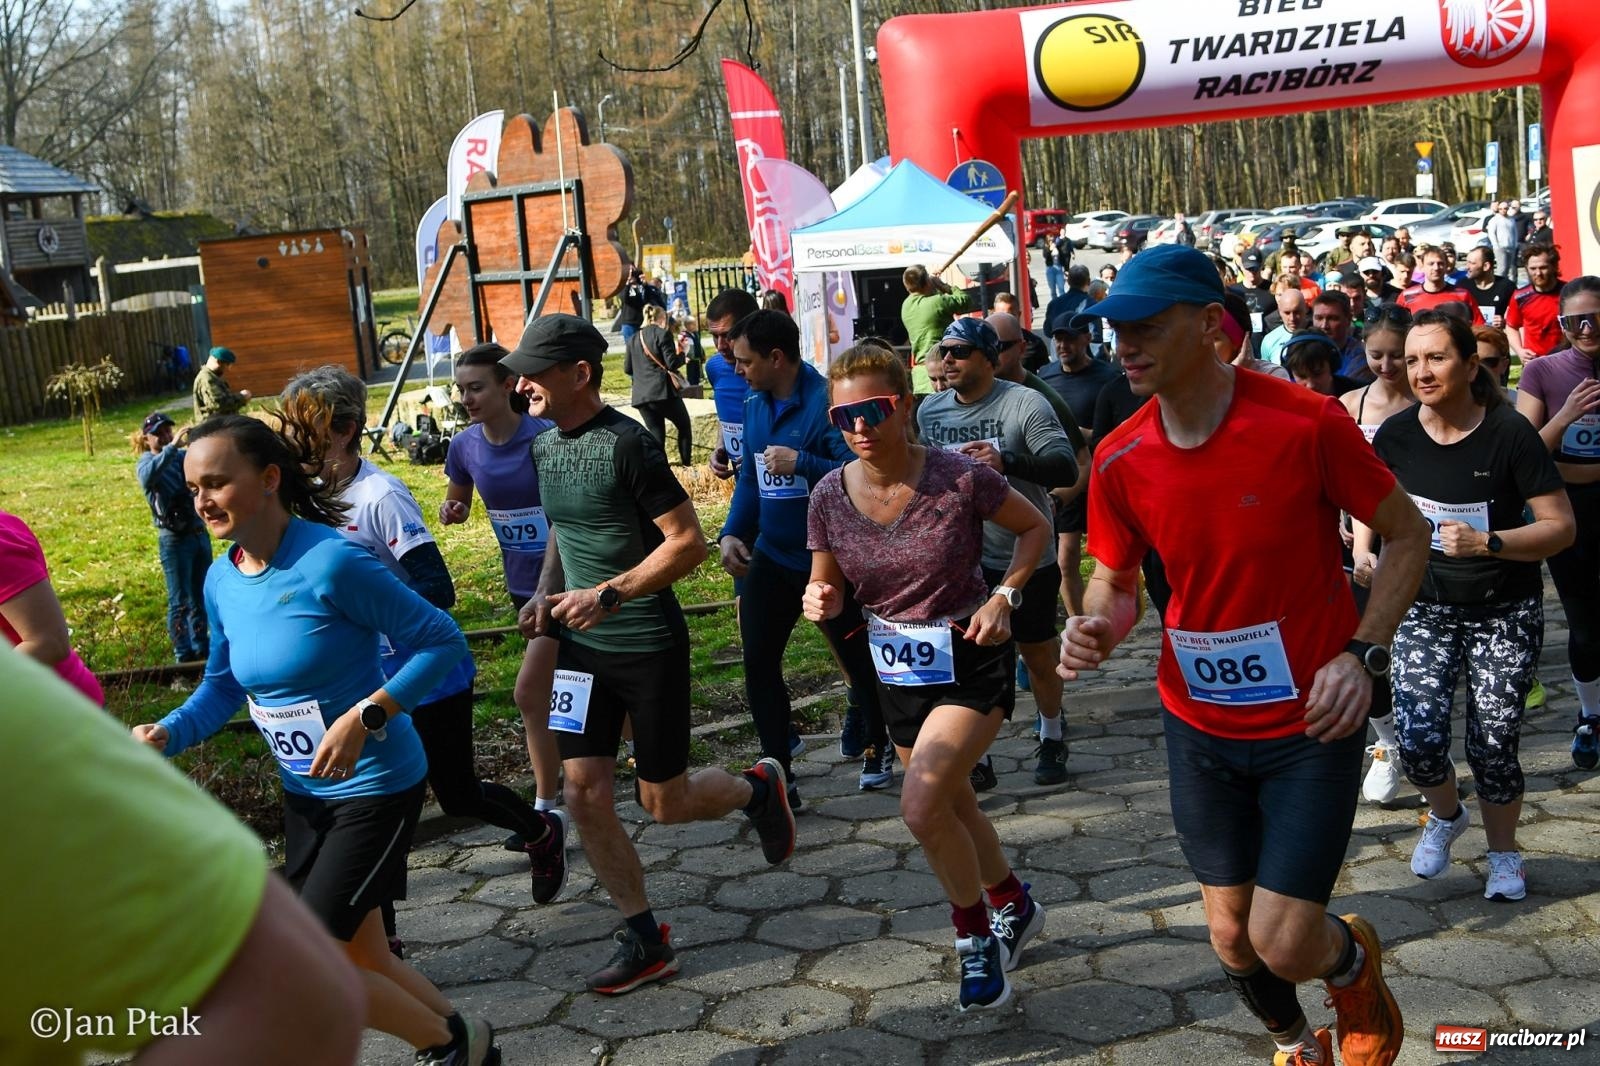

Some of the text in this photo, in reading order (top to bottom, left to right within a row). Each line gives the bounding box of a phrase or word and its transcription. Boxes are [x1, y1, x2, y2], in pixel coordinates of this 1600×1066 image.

[1084, 23, 1140, 44] SIR
[1169, 16, 1406, 64] TWARDZIELA
[1193, 58, 1382, 100] RACIBÓRZ
[932, 419, 1005, 443] CrossFit
[763, 470, 795, 486] 089
[501, 524, 538, 540] 079
[1175, 629, 1270, 646] XIV BIEG TWARDZIELA
[881, 641, 935, 667] 049
[1194, 654, 1267, 685] 086
[266, 708, 312, 720] TWARDZIELA
